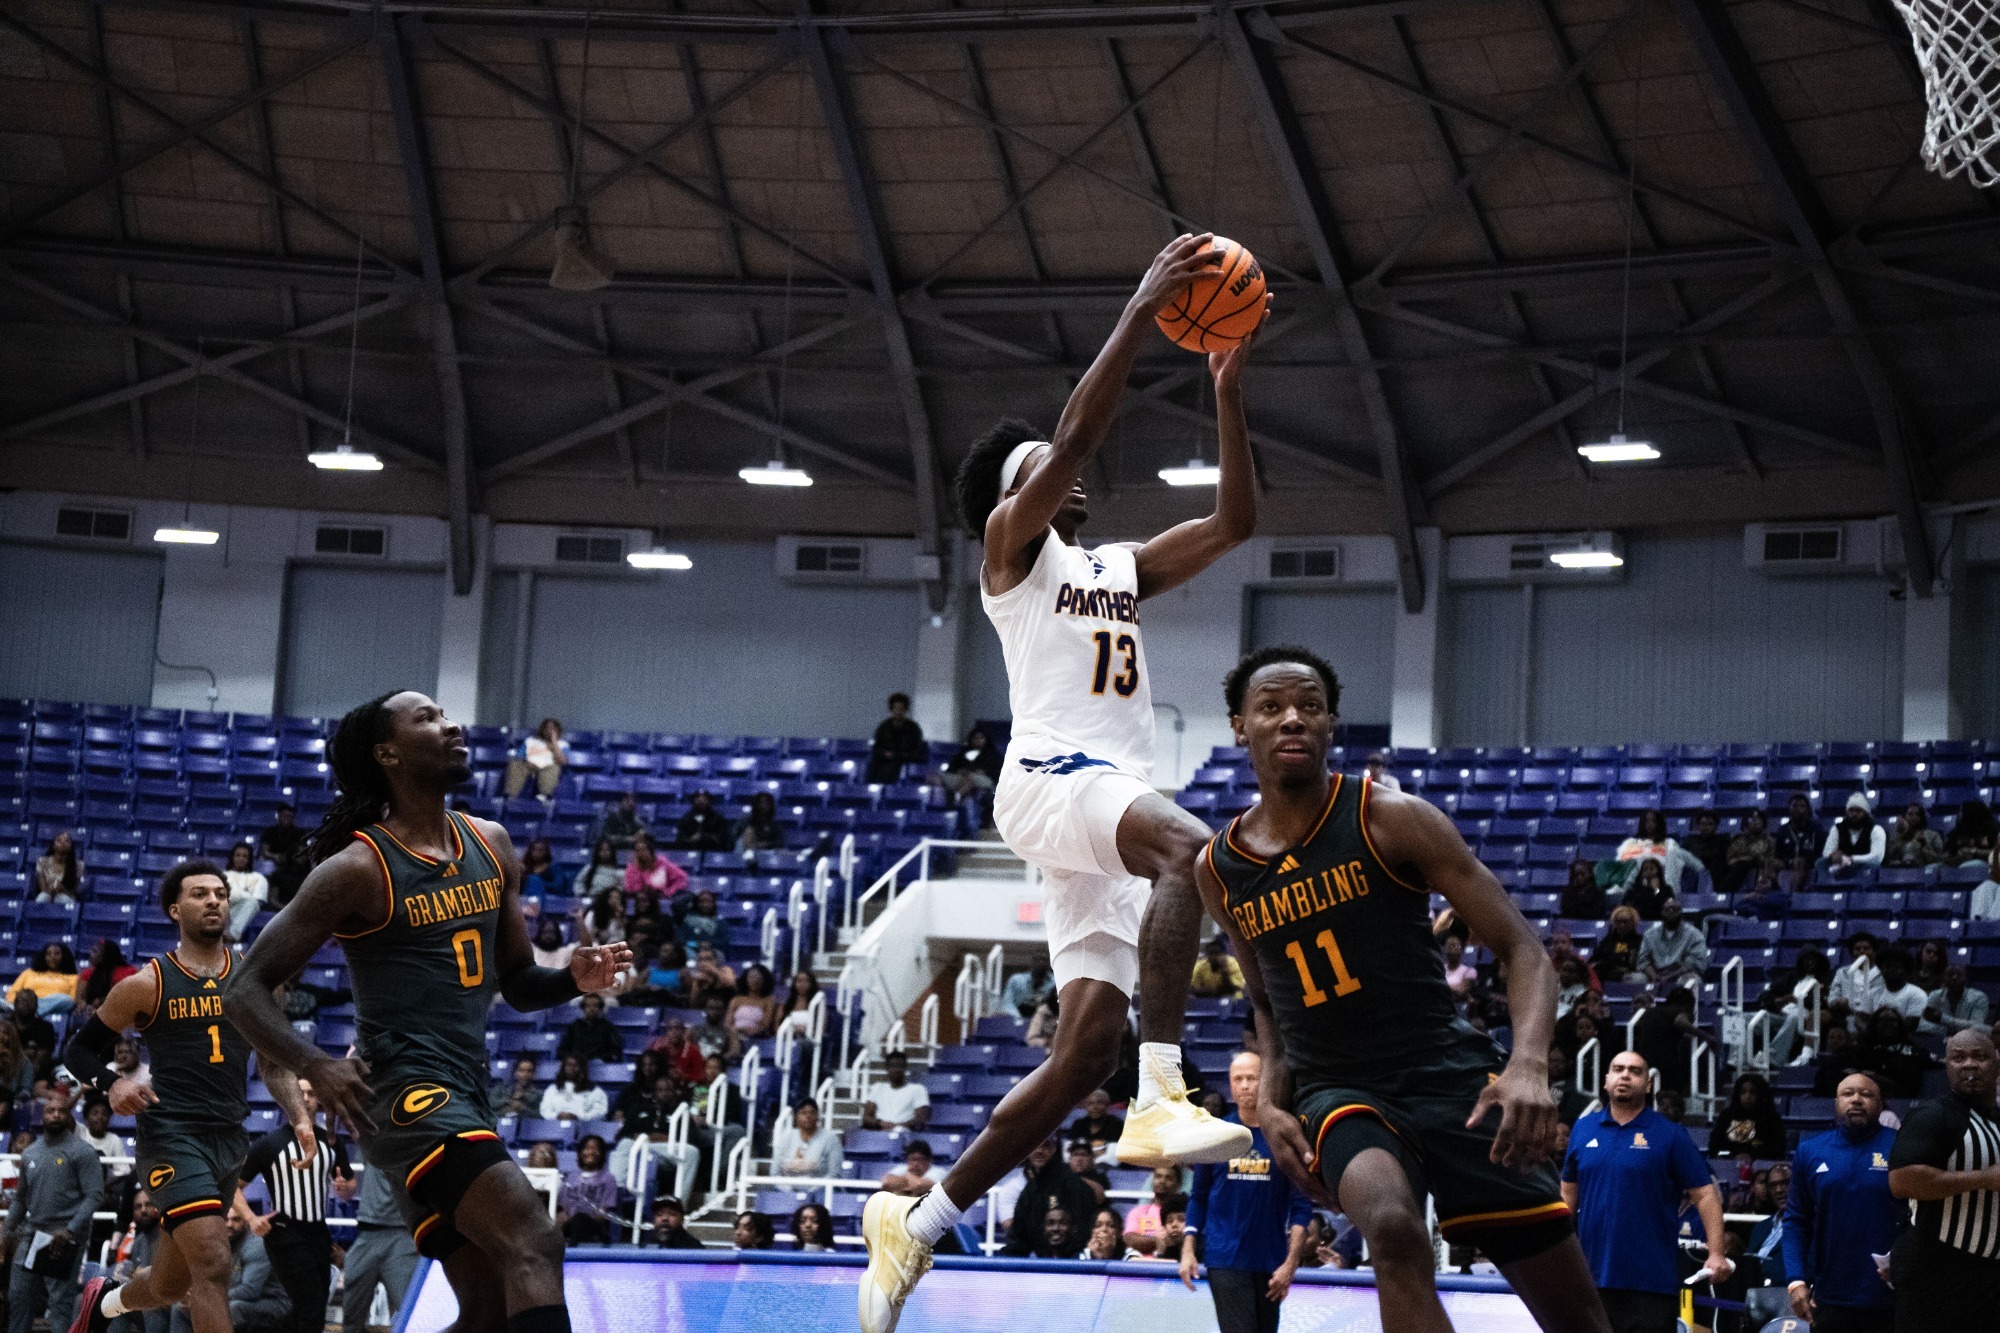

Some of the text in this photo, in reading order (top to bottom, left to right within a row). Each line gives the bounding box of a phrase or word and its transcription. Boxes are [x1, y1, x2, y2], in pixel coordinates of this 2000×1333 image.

[1091, 628, 1139, 698] 13
[1232, 860, 1370, 940] GRAMBLING
[452, 928, 484, 988] 0
[1285, 928, 1362, 1007] 11
[207, 1025, 225, 1064] 1
